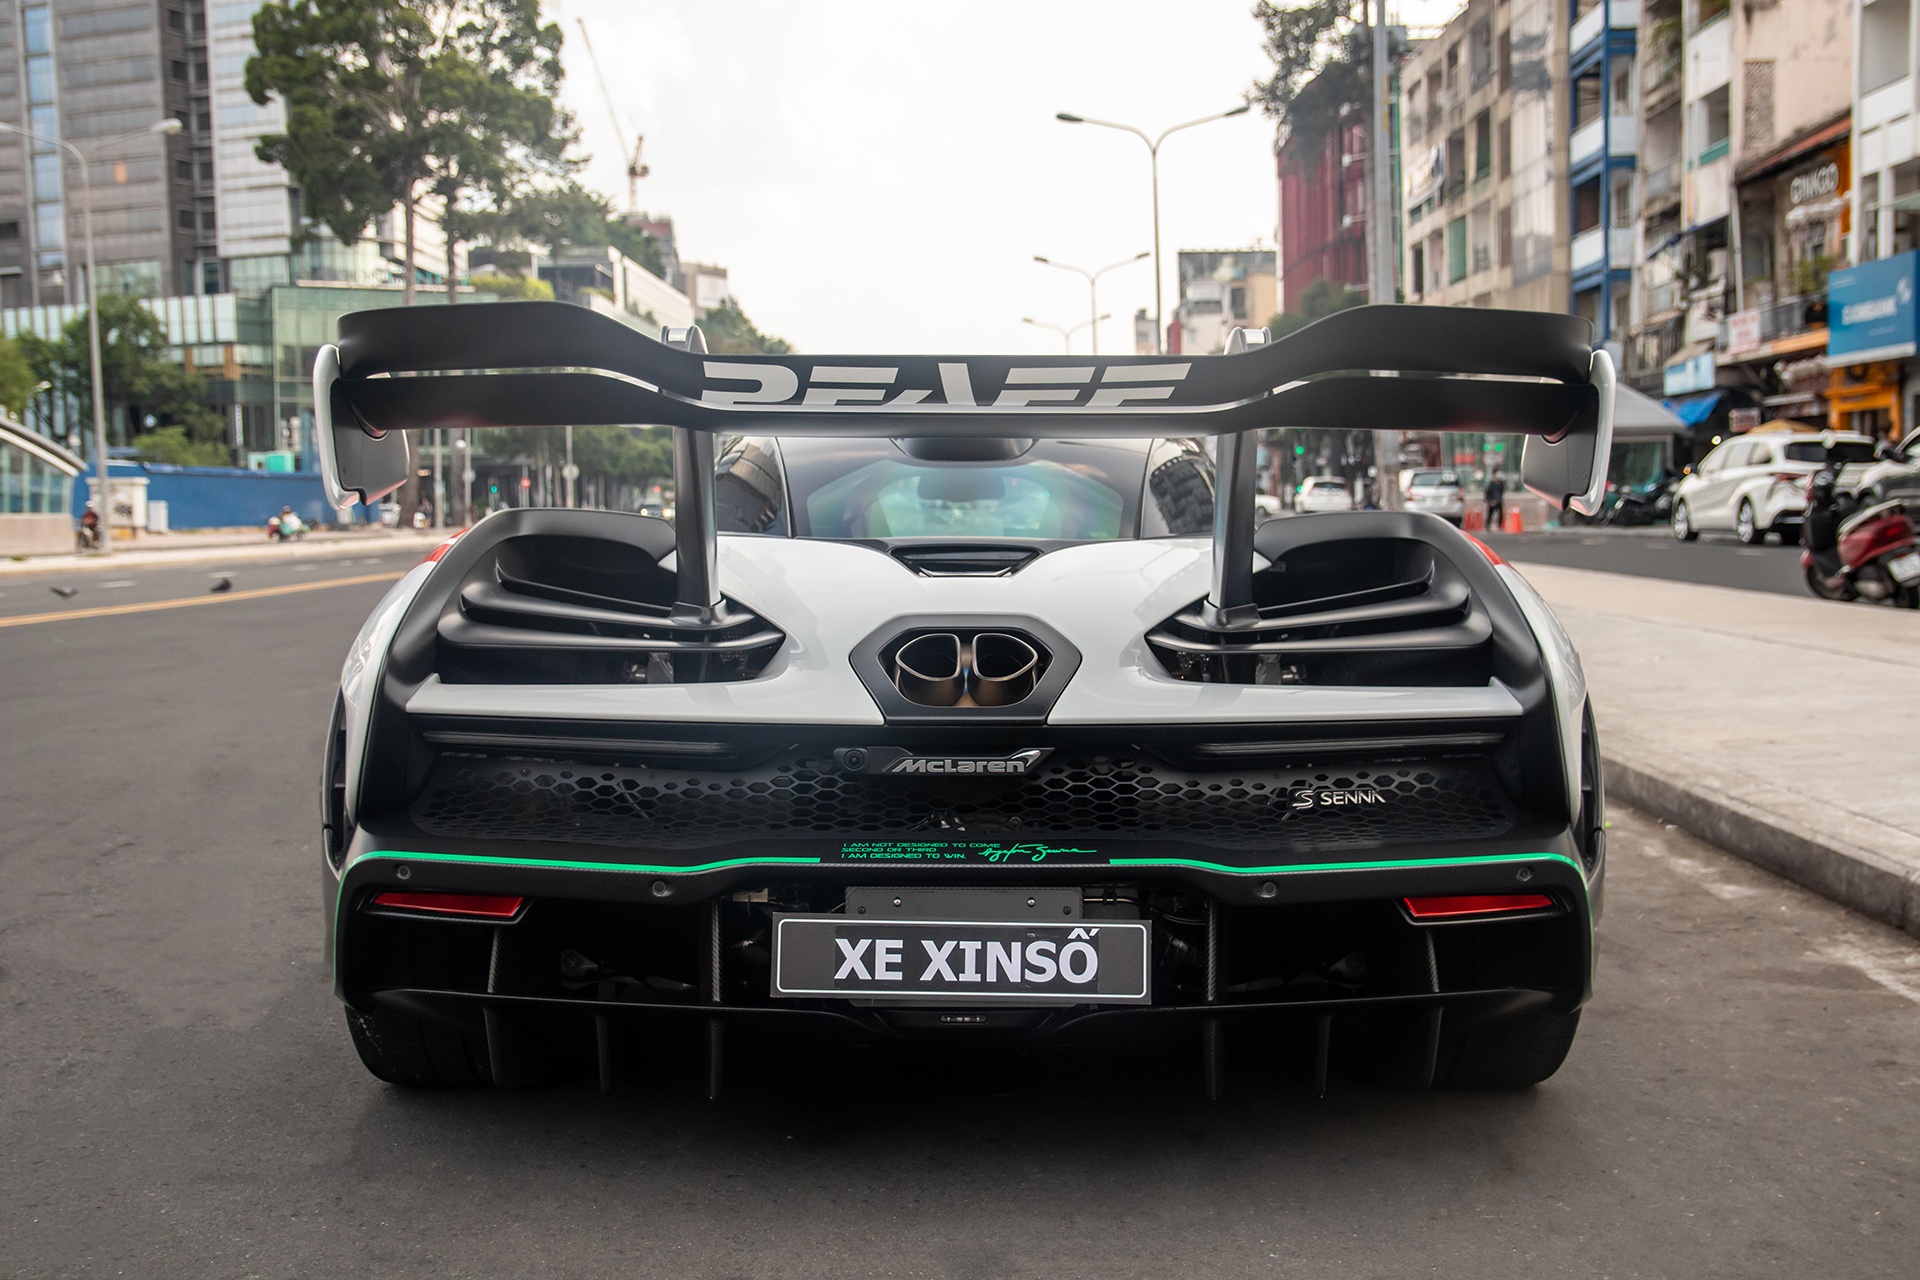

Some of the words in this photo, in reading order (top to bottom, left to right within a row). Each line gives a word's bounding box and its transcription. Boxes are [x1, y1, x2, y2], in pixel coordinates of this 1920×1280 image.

[892, 759, 1024, 773] McLaren
[1320, 791, 1386, 806] SENNA
[834, 938, 904, 981] XE
